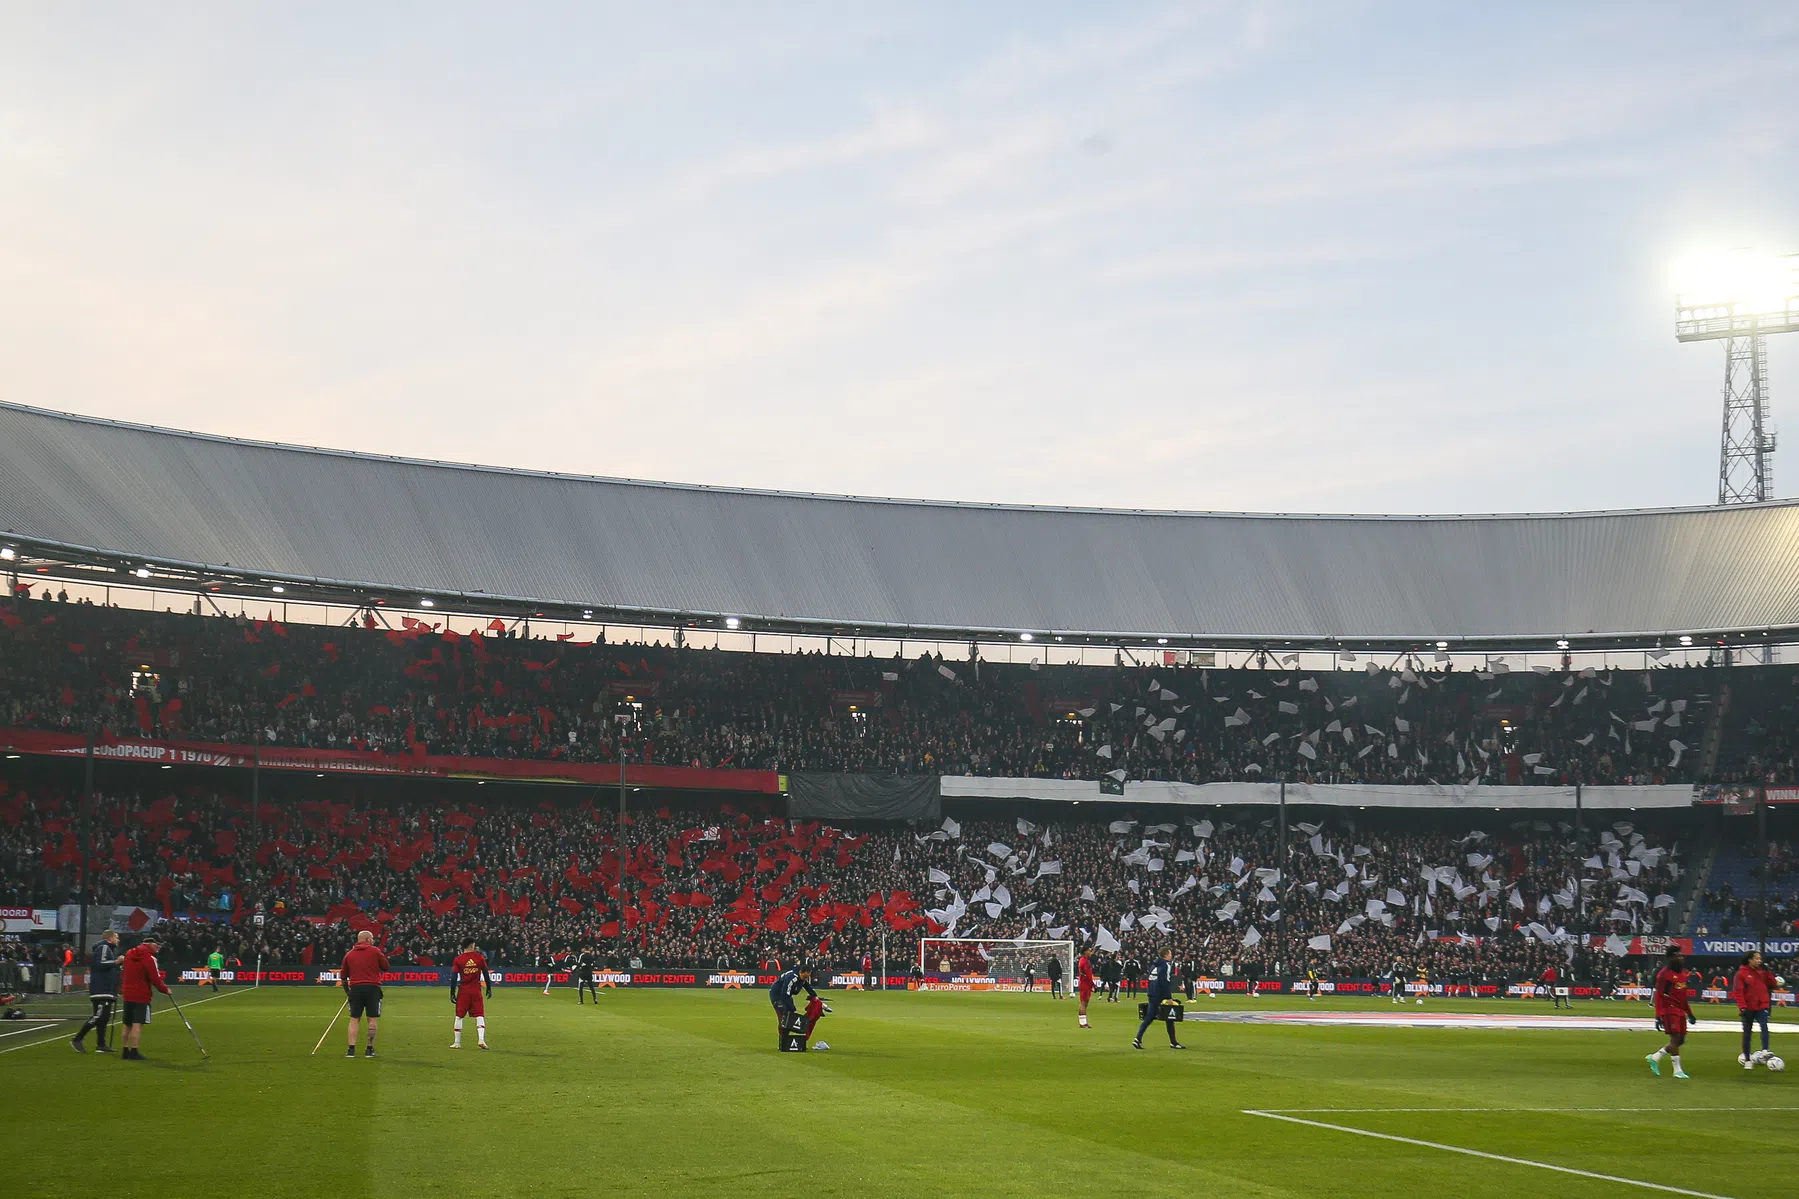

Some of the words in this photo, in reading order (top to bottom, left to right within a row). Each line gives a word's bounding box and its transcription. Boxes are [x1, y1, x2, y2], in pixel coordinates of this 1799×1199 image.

[0, 909, 28, 917] OORD
[182, 970, 234, 980] HOLLYOD
[237, 972, 267, 981] EVENT
[269, 972, 305, 981] CENTER
[379, 972, 402, 981] VENT
[404, 972, 439, 981] CENTER
[505, 973, 534, 982] EVENT
[535, 973, 569, 982] CETER
[592, 974, 631, 983] LLYWOOD
[633, 974, 661, 983] EVENT
[663, 974, 695, 983] CENTER
[709, 975, 755, 984] HOLLYWOOD
[832, 976, 877, 984] HOLLYWD
[1196, 981, 1224, 989] LYWOOD
[1258, 982, 1282, 990] ENTER
[1293, 982, 1335, 990] HOLLOOD
[1337, 983, 1361, 991] EVENT
[1617, 988, 1652, 996] OLLYWOOD
